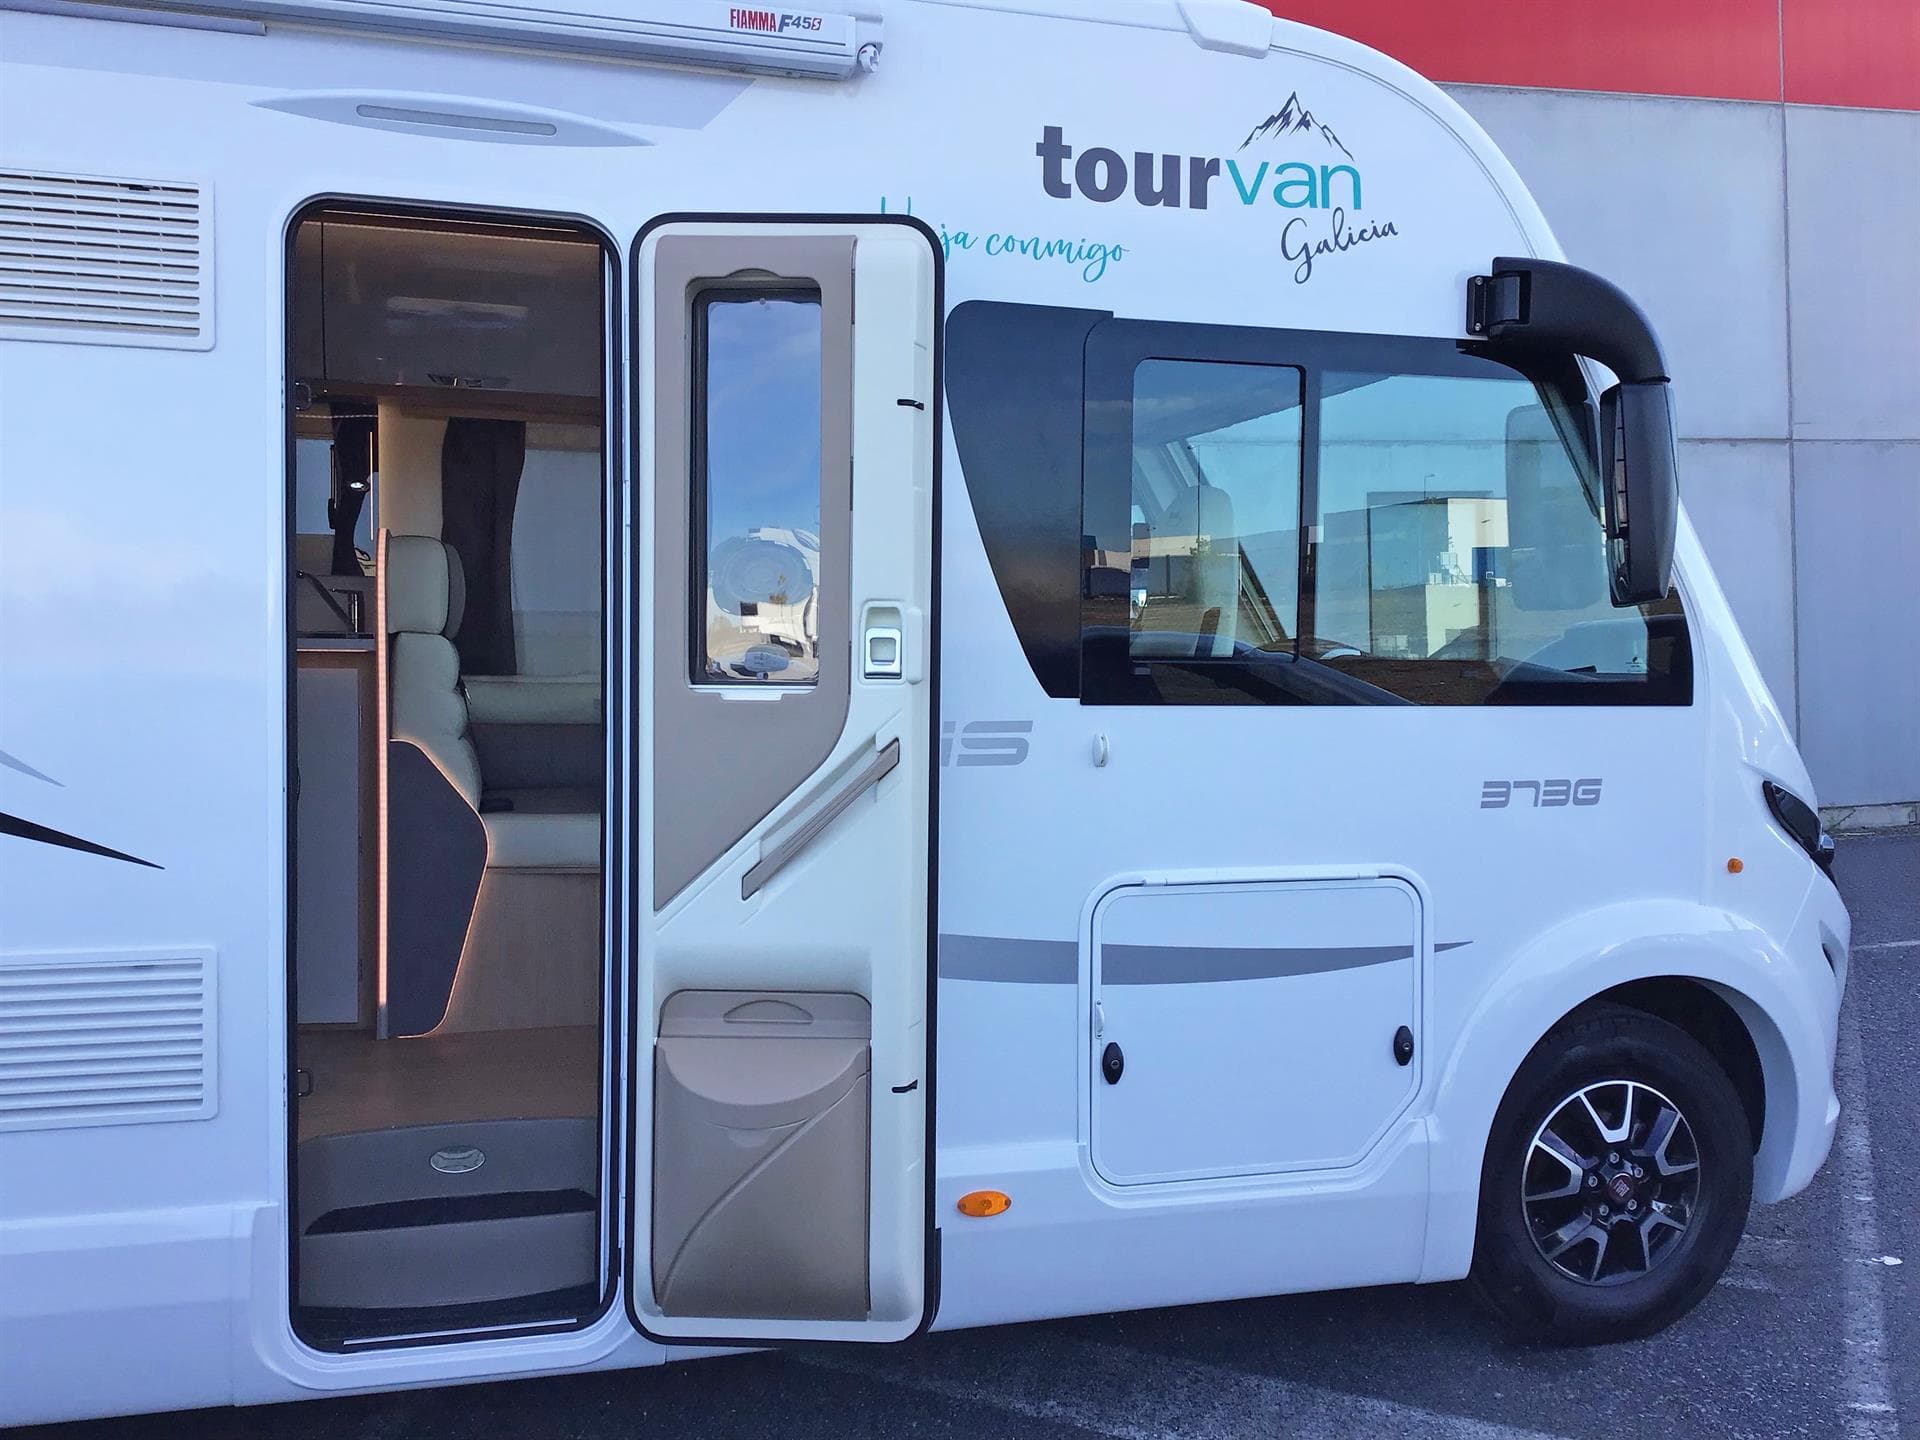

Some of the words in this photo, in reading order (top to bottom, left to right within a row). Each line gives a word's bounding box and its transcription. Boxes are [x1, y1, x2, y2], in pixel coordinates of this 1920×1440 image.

[730, 8, 777, 32] FIAMMA
[1036, 125, 1362, 210] tourvan
[985, 231, 1130, 283] conmigo
[1281, 206, 1399, 284] Galicia
[1480, 778, 1603, 809] 373G
